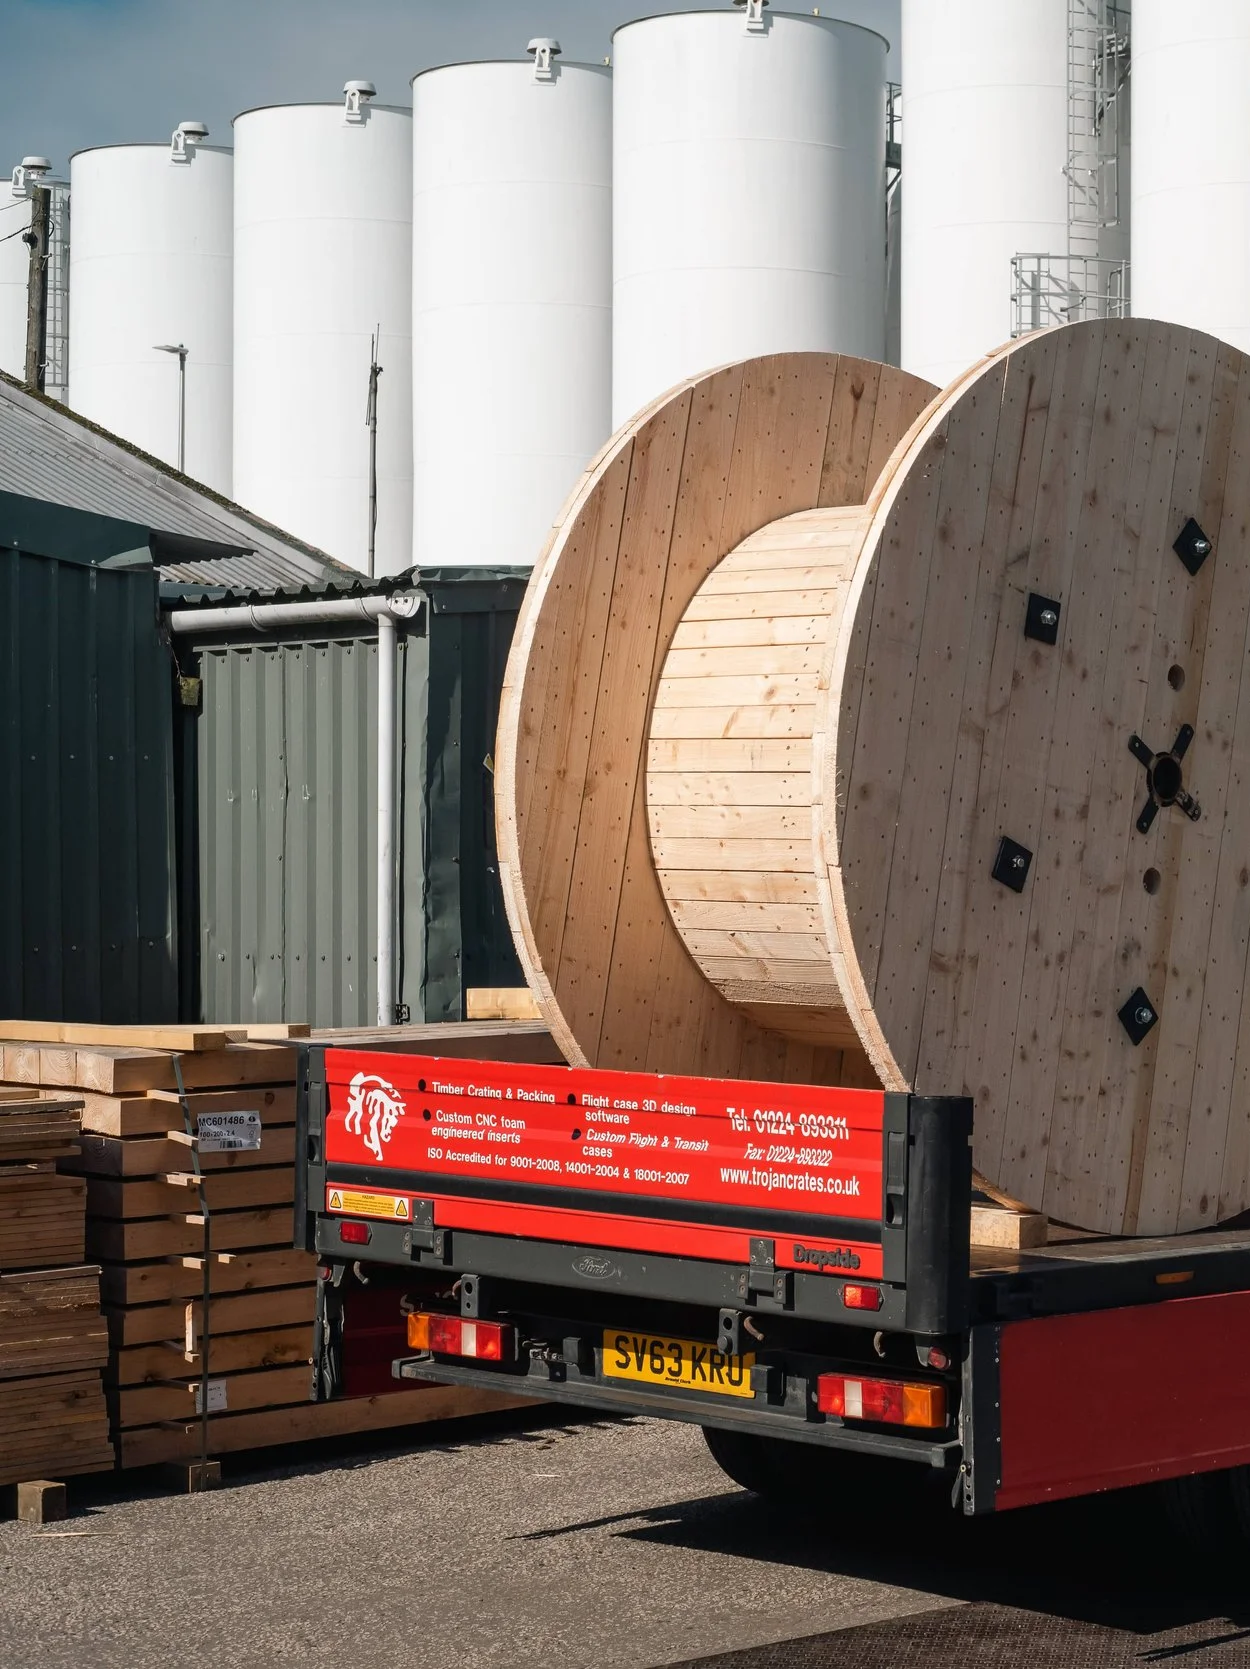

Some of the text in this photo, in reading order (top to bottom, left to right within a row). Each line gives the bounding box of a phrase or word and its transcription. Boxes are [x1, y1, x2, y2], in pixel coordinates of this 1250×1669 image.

[431, 1081, 556, 1104] Timber Crating & Packing
[581, 1093, 697, 1117] Flight case 3D design
[198, 1115, 245, 1127] MC601486
[435, 1109, 526, 1130] Custom CNC foam
[585, 1110, 630, 1125] software
[753, 1108, 850, 1141] 01224-893311
[431, 1125, 521, 1144] engineered inserts
[586, 1128, 710, 1152] Custom Flight & Transit
[582, 1145, 613, 1158] cases
[765, 1144, 833, 1167] 01224-893322
[427, 1147, 690, 1185] ISO Accredited for 9001-2008, 14001-2004 & 18001-2007
[720, 1166, 861, 1196] www.trojancrates.co.uk
[793, 1243, 861, 1271] Dropside
[613, 1334, 683, 1378] SV63
